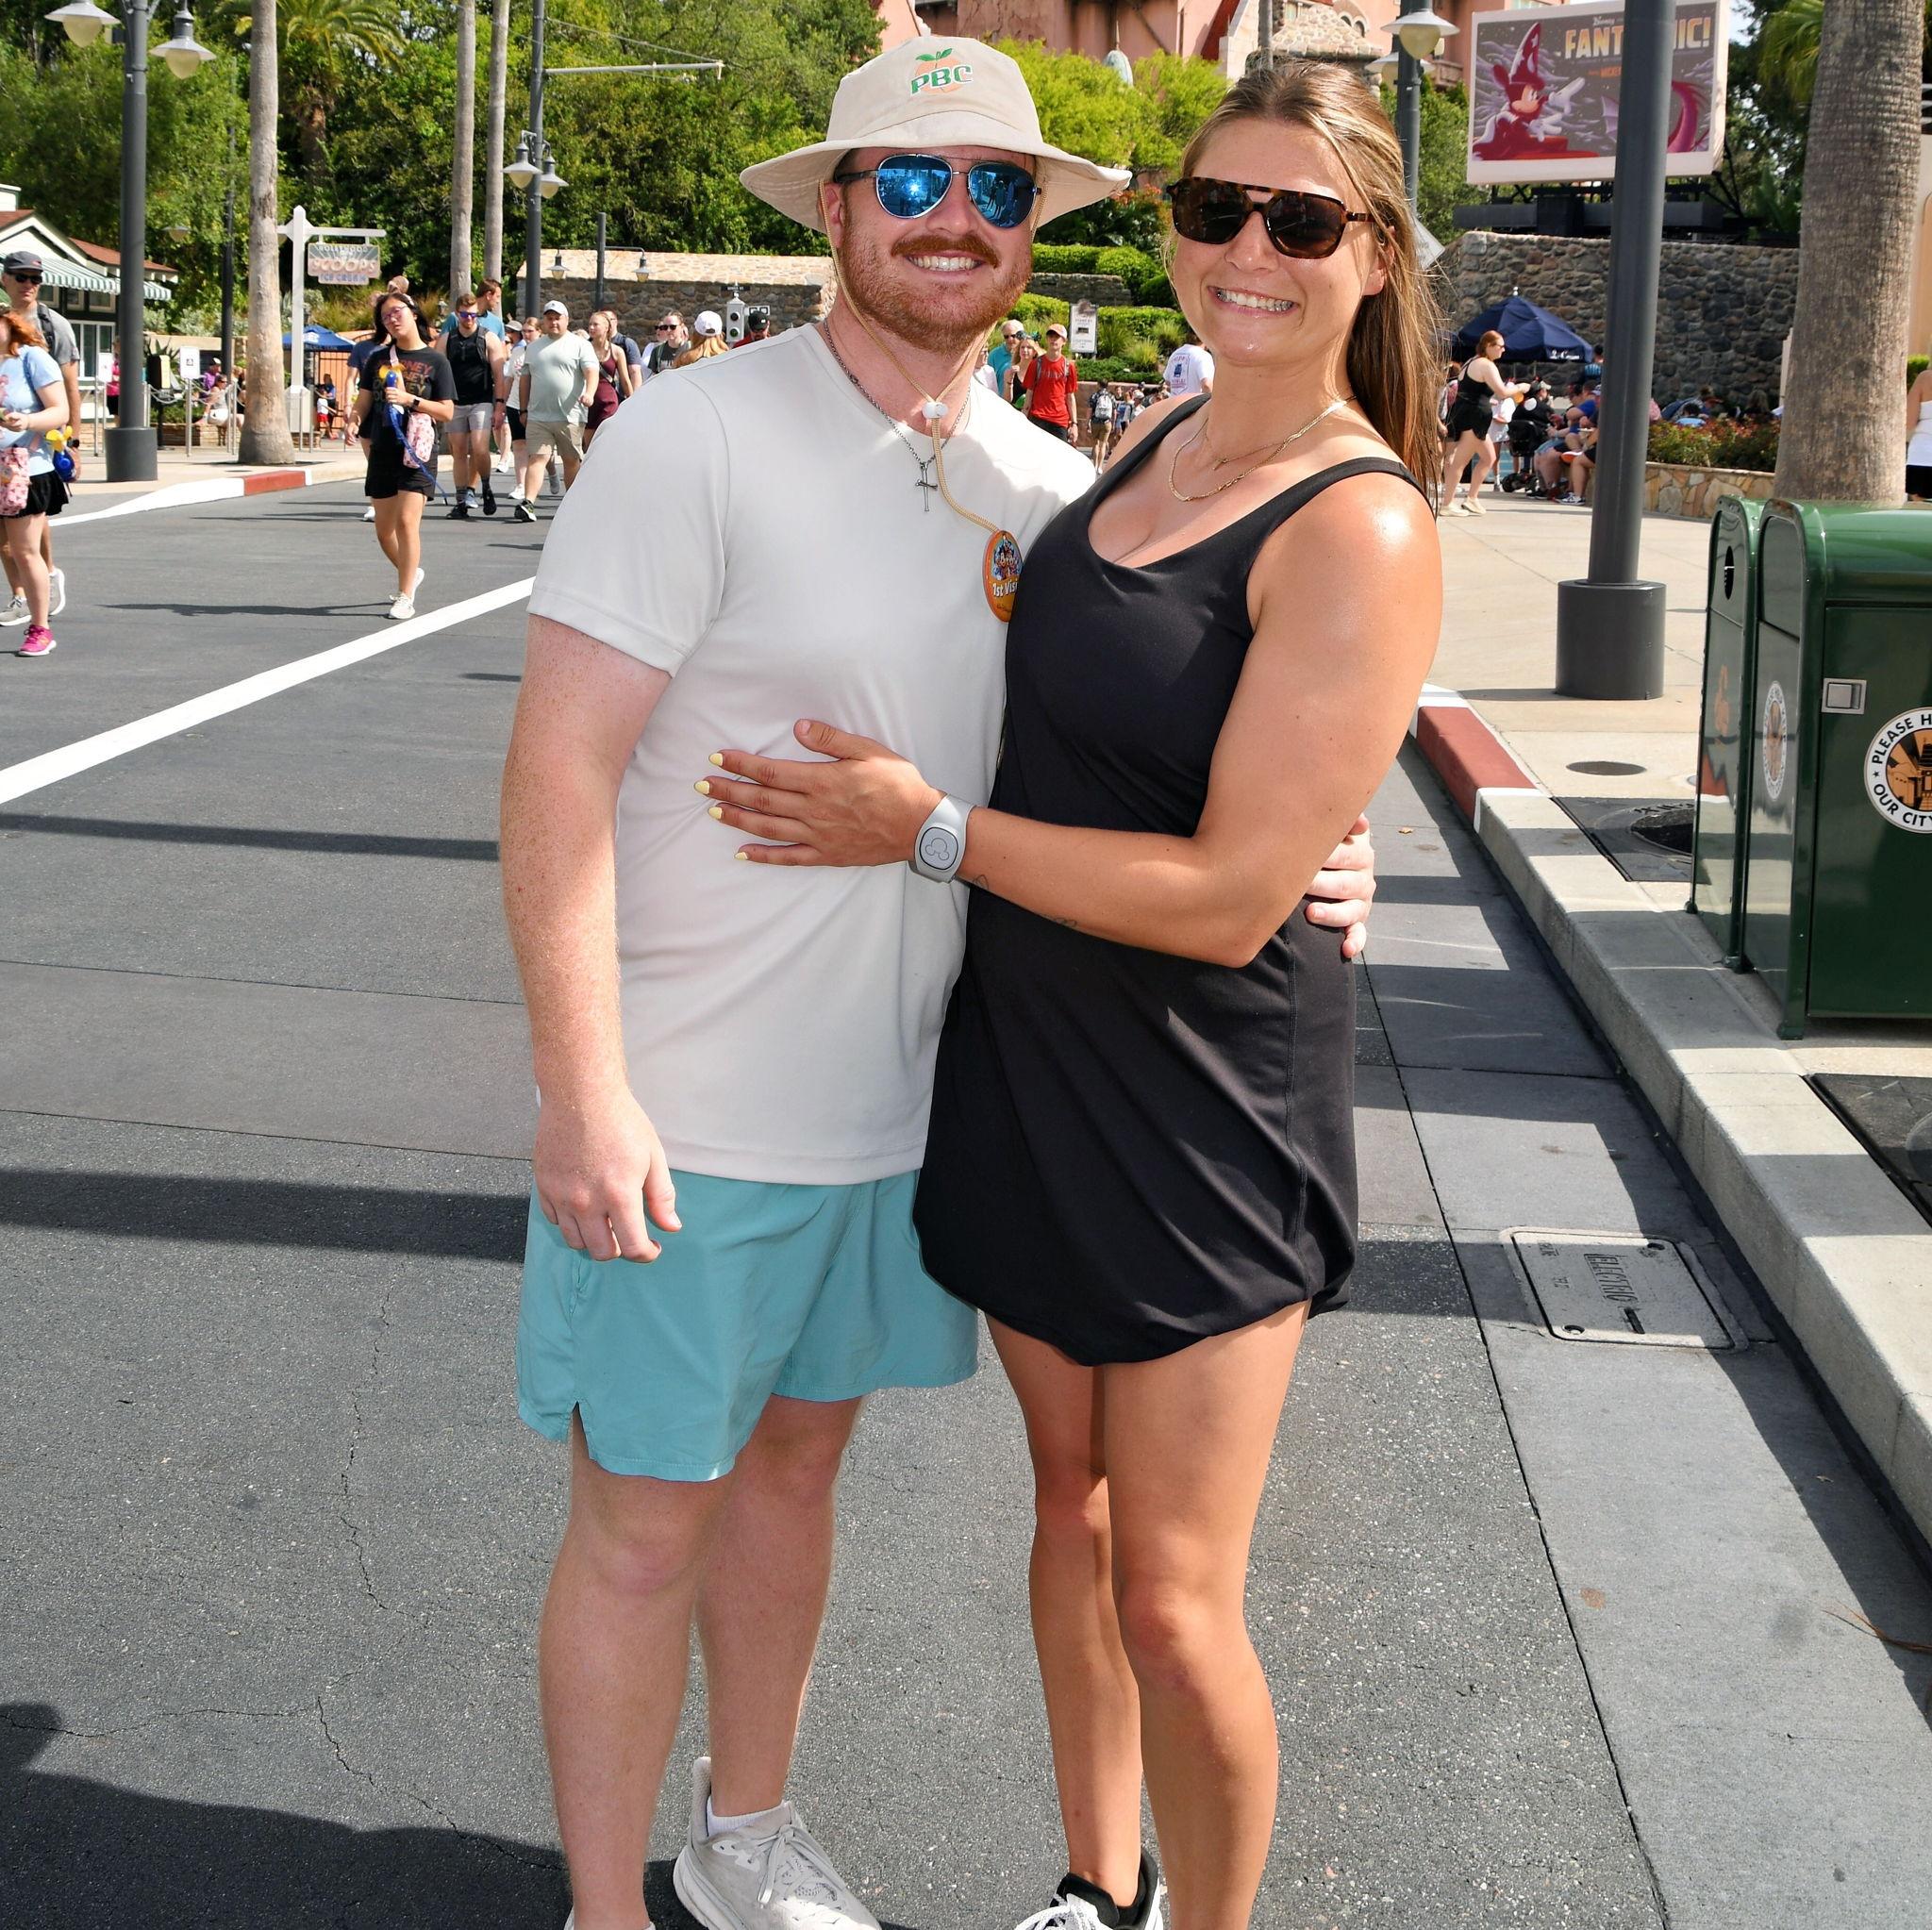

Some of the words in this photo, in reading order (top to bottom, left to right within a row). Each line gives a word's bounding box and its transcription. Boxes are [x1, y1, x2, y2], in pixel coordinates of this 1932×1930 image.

[1565, 17, 1711, 59] FANTIC!
[910, 64, 974, 94] PBC
[312, 257, 377, 272] SCOOPS
[992, 582, 1005, 597] 1st
[1005, 577, 1018, 594] Visi
[1872, 717, 1914, 764] PLEASE
[1874, 783, 1899, 815] OUR
[1587, 1256, 1639, 1303] ELECTRIC
